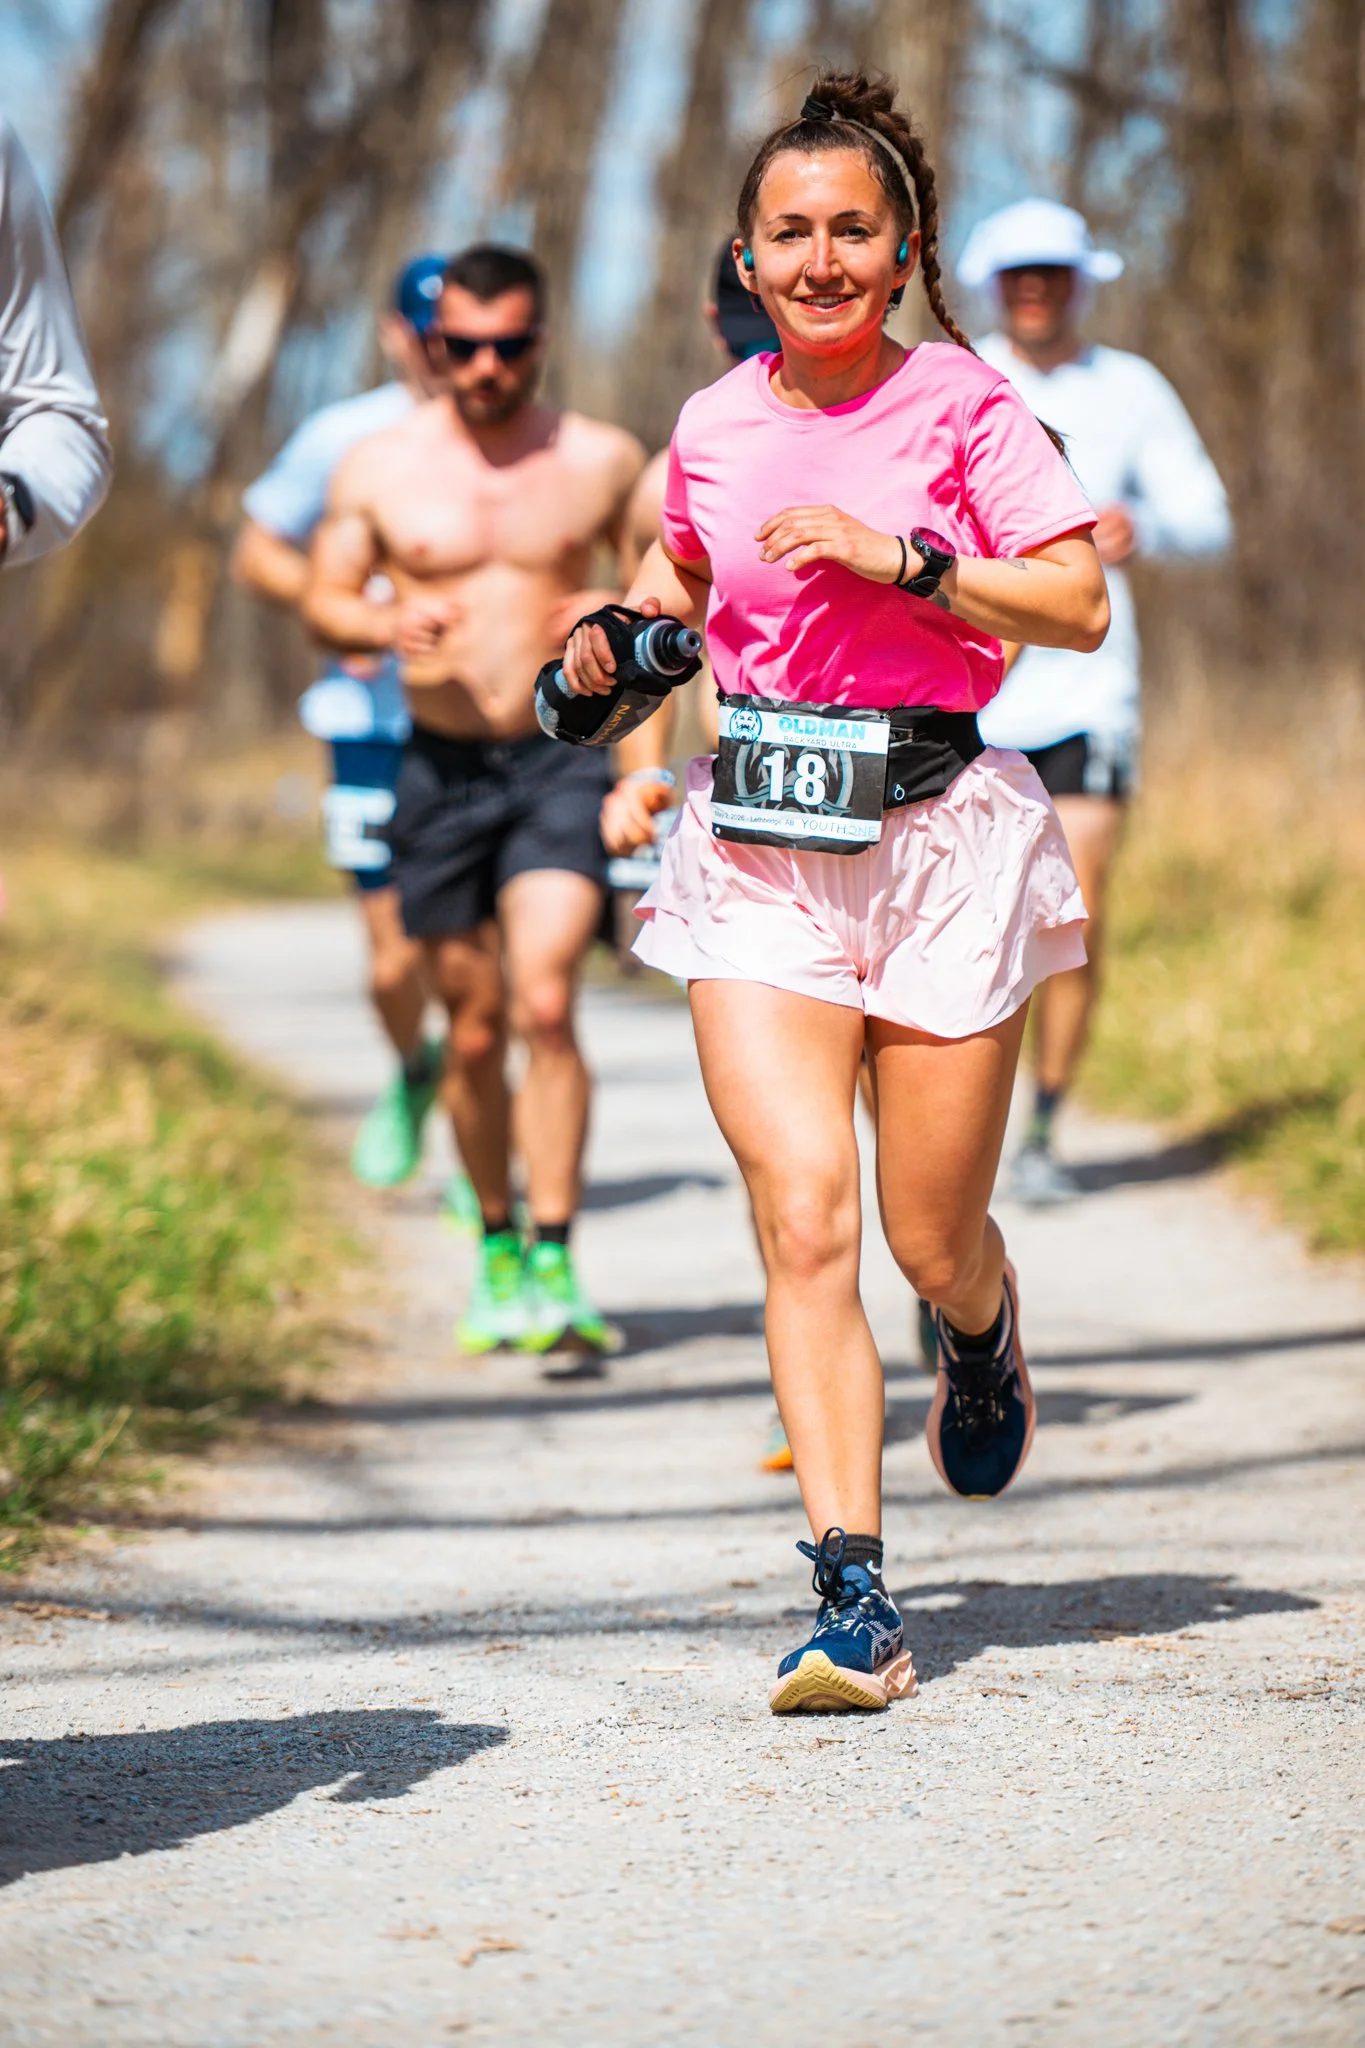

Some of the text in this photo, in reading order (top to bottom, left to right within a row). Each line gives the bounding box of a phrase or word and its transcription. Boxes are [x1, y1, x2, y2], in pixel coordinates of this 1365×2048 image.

[778, 716, 866, 740] OLDMAN
[783, 735, 857, 749] BACKYARD ULTRA
[762, 751, 827, 806] 18
